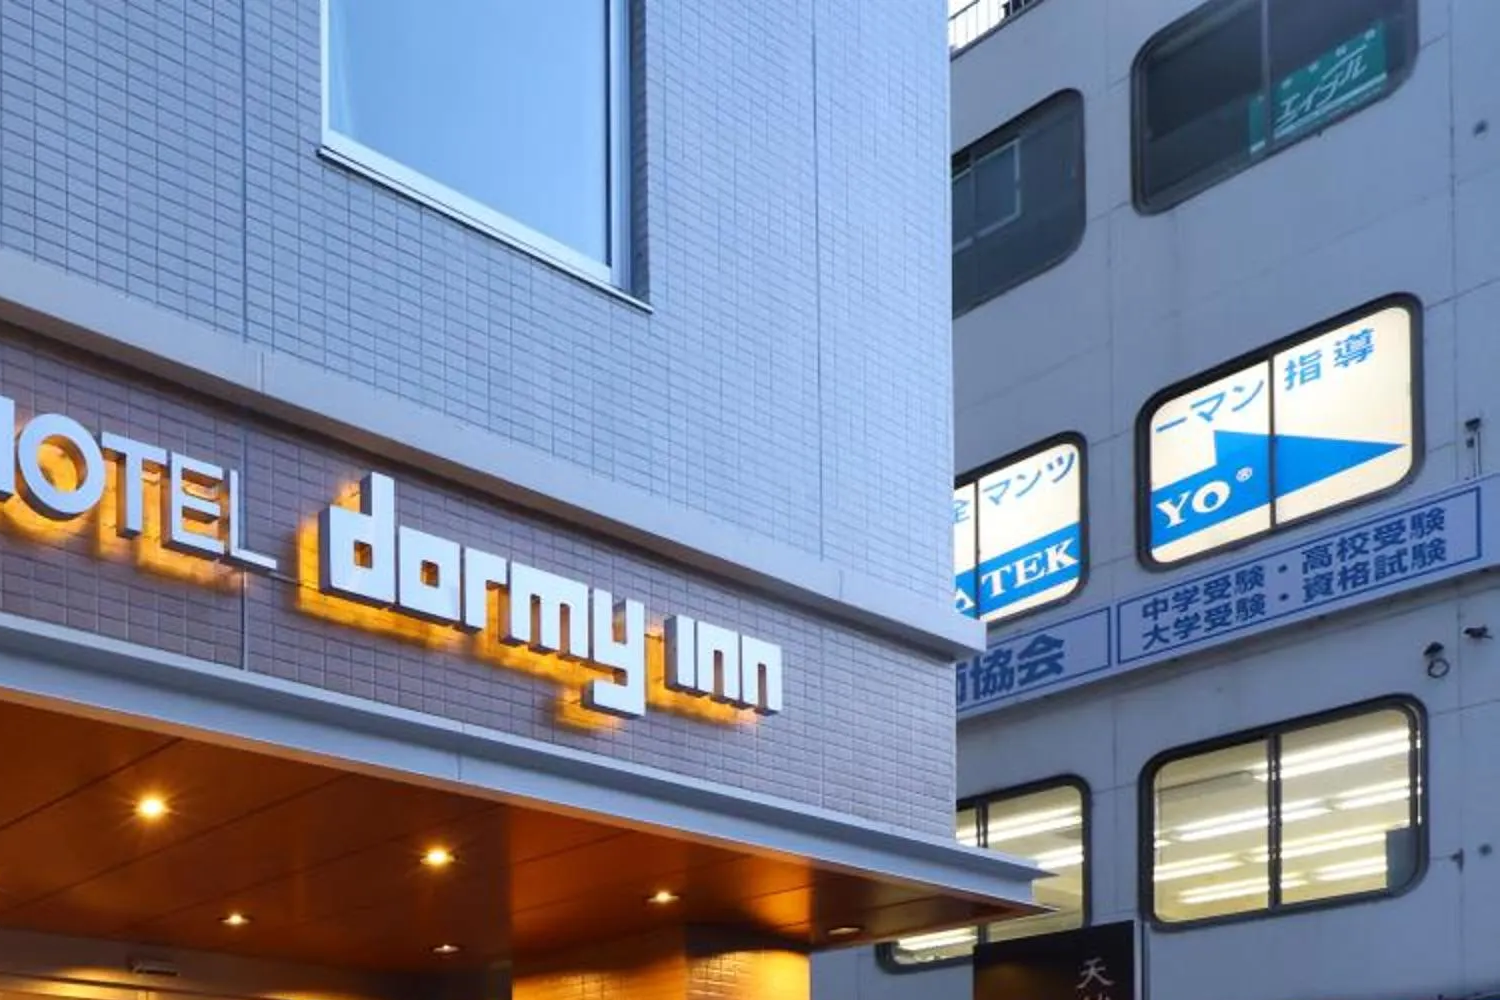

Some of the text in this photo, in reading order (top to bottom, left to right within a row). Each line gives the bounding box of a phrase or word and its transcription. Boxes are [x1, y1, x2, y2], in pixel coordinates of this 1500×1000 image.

[319, 472, 783, 717] dormy inn
[1142, 507, 1446, 621] 中学受験・高校受験
[1142, 538, 1447, 650] 大学受験・資格試験
